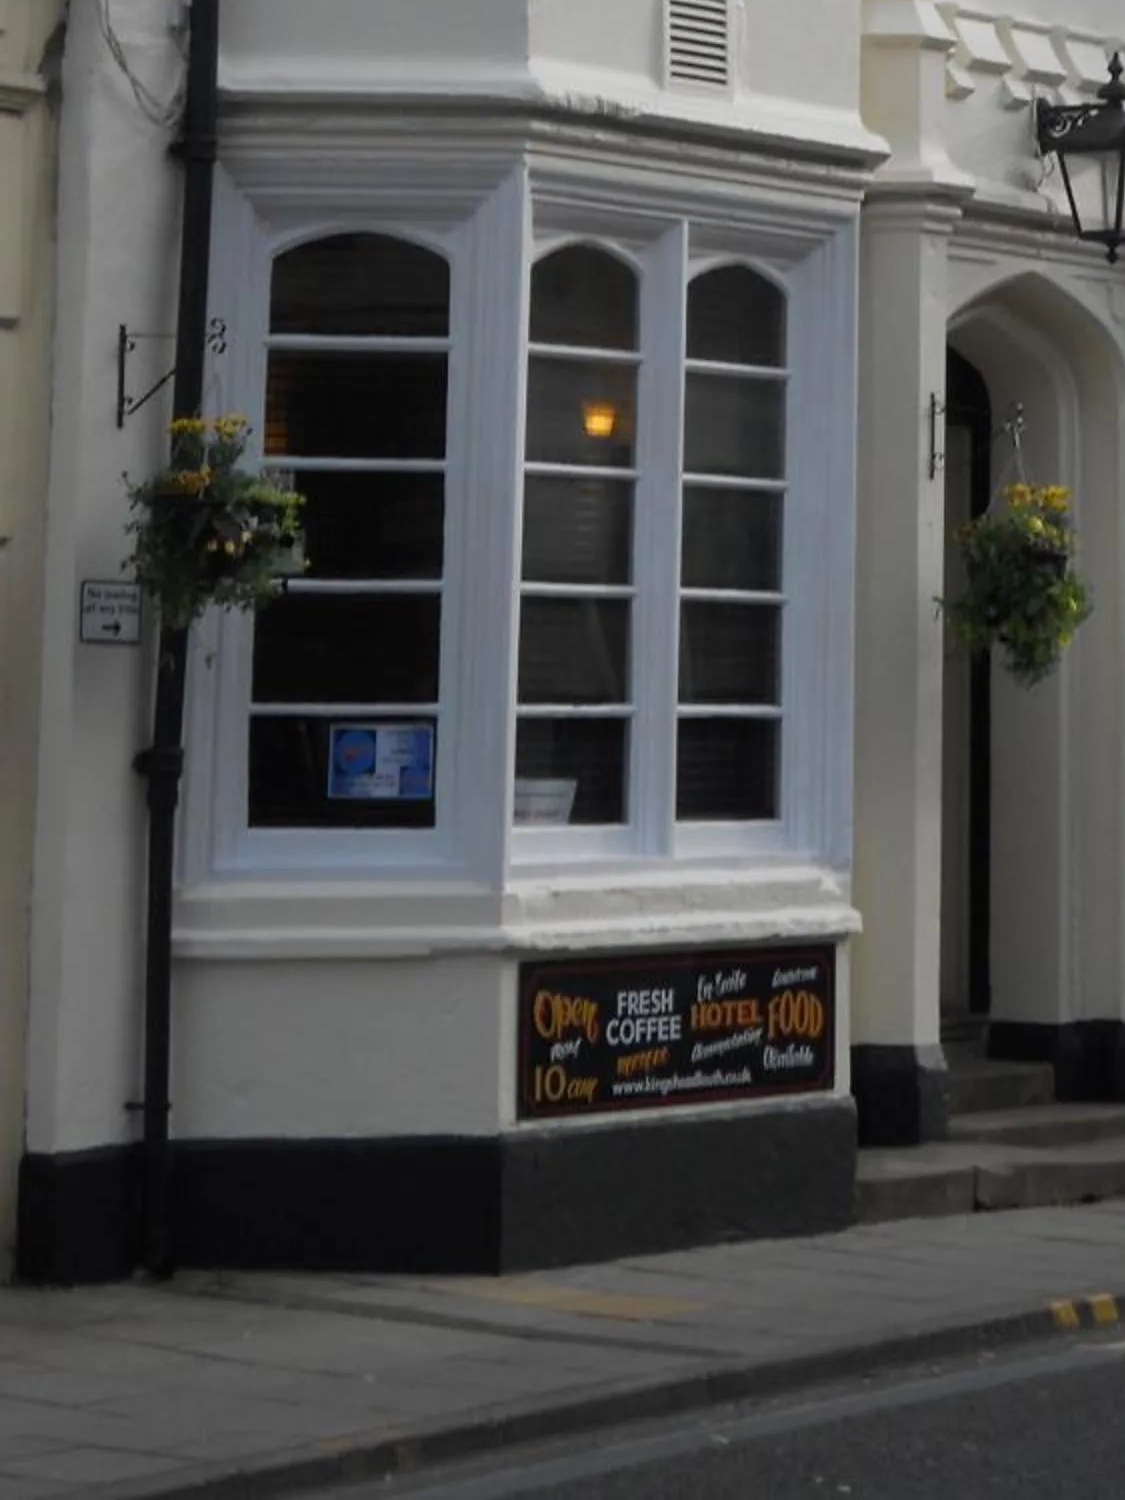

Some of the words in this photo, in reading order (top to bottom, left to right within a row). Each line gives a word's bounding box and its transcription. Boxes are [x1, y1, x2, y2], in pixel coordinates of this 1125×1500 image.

[533, 990, 600, 1044] Open
[617, 988, 674, 1017] FRESH
[690, 998, 763, 1030] HOTEL
[767, 989, 824, 1042] FOOD
[606, 1014, 682, 1047] COFFEE
[535, 1065, 566, 1102] 10
